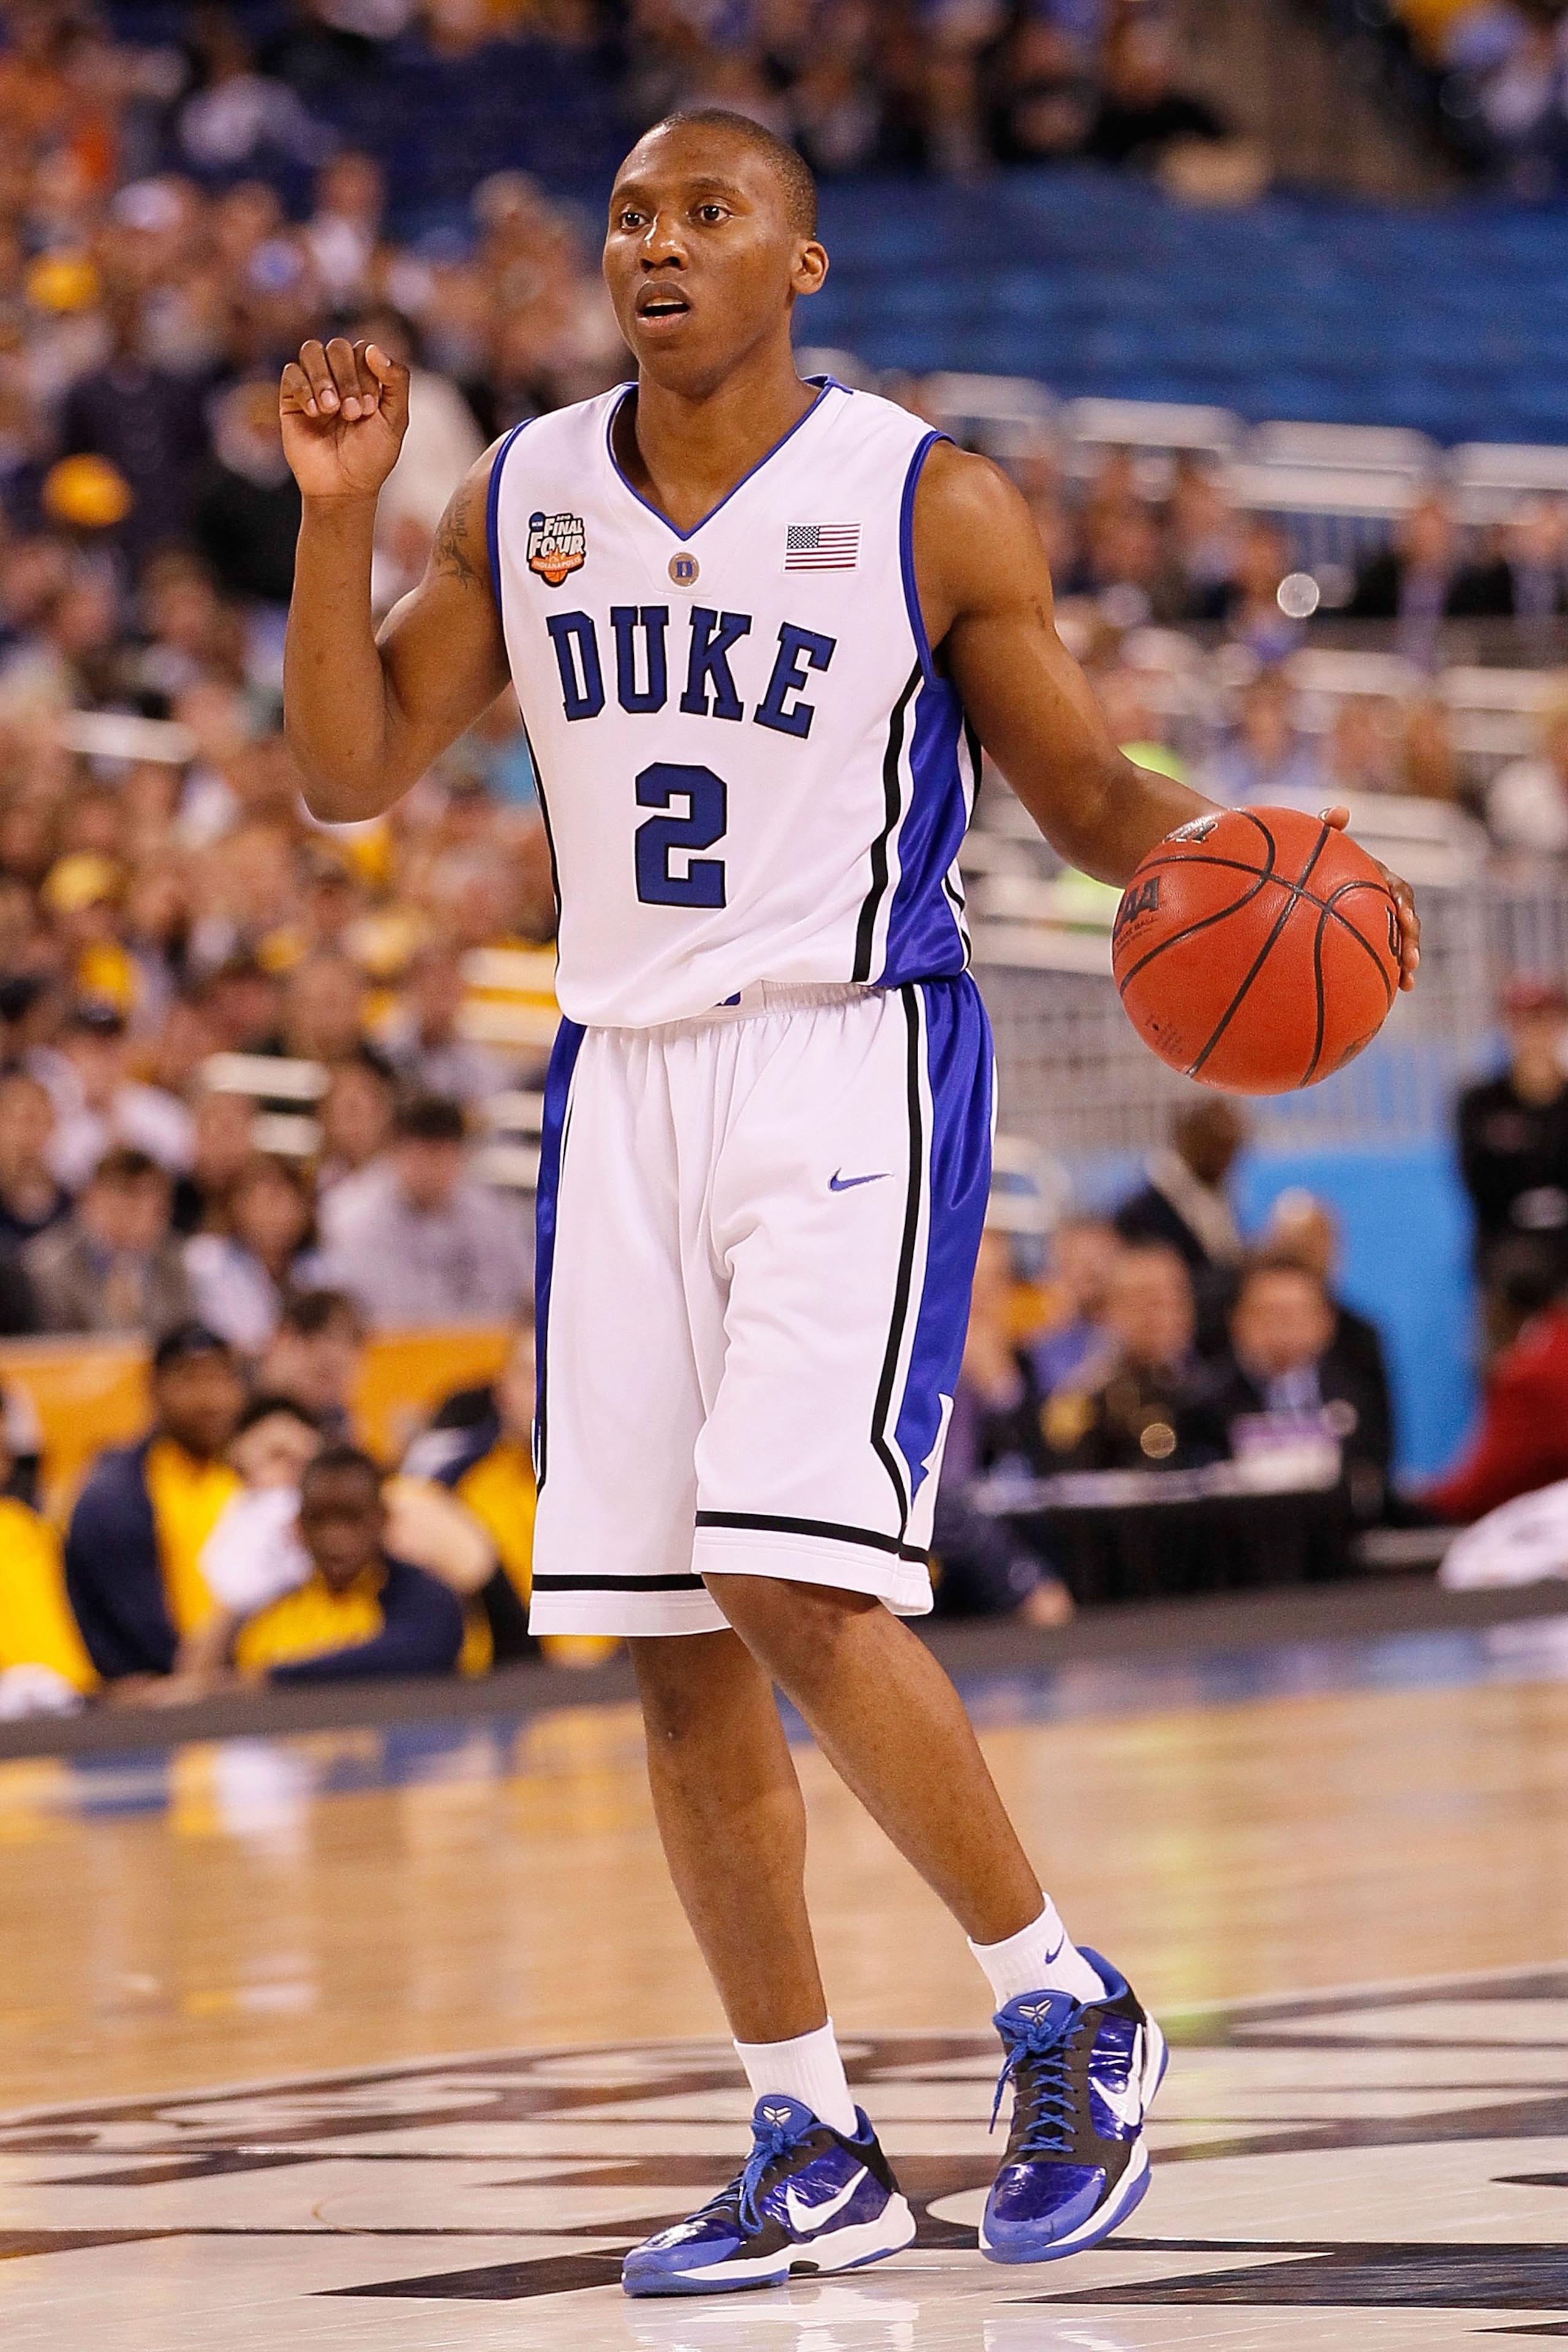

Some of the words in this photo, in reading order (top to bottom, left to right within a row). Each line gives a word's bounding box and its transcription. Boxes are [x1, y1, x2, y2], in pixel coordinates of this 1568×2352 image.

[528, 534, 584, 560] FOUR
[543, 517, 582, 537] FINAL
[546, 605, 837, 739] DUKE
[635, 763, 727, 909] 2
